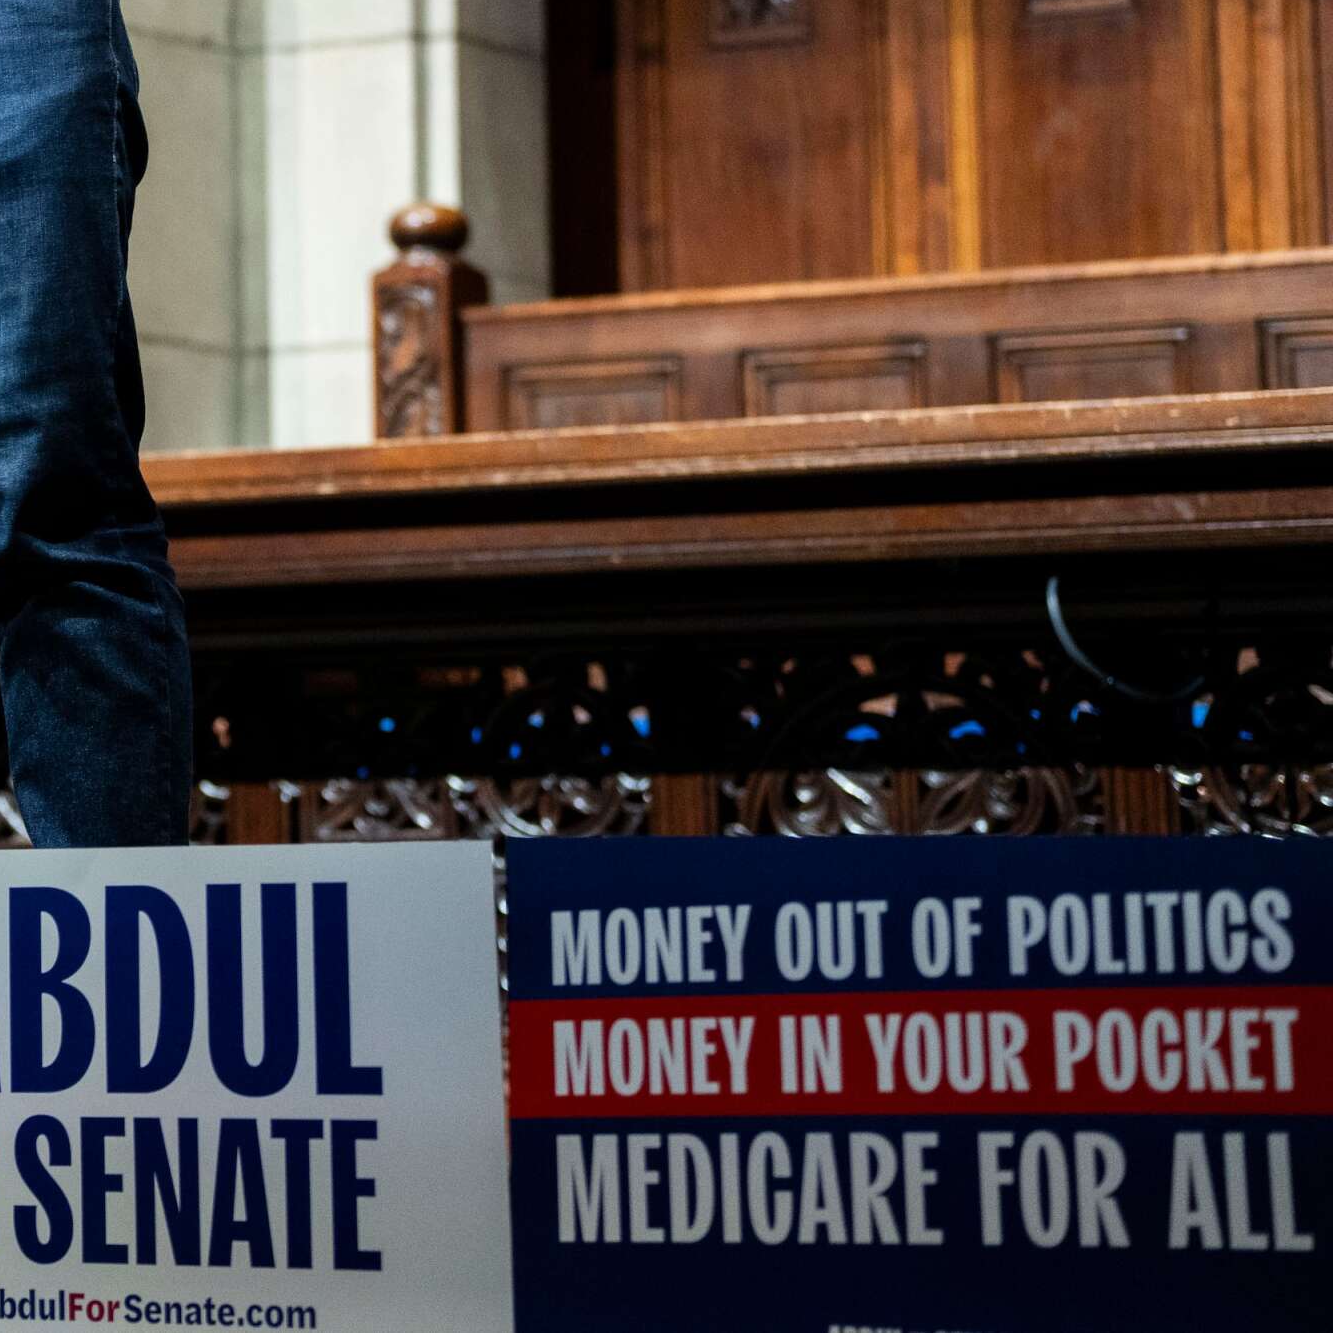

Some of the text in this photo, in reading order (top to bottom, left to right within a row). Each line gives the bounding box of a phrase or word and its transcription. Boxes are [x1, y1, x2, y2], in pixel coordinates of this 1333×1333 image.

[551, 889, 1294, 986] MONEY OUT OF POLITICS
[553, 1008, 1299, 1097] MONEY IN YOUR POCKET
[13, 1114, 383, 1271] SENATE
[556, 1130, 1315, 1251] MEDICARE FOR ALL
